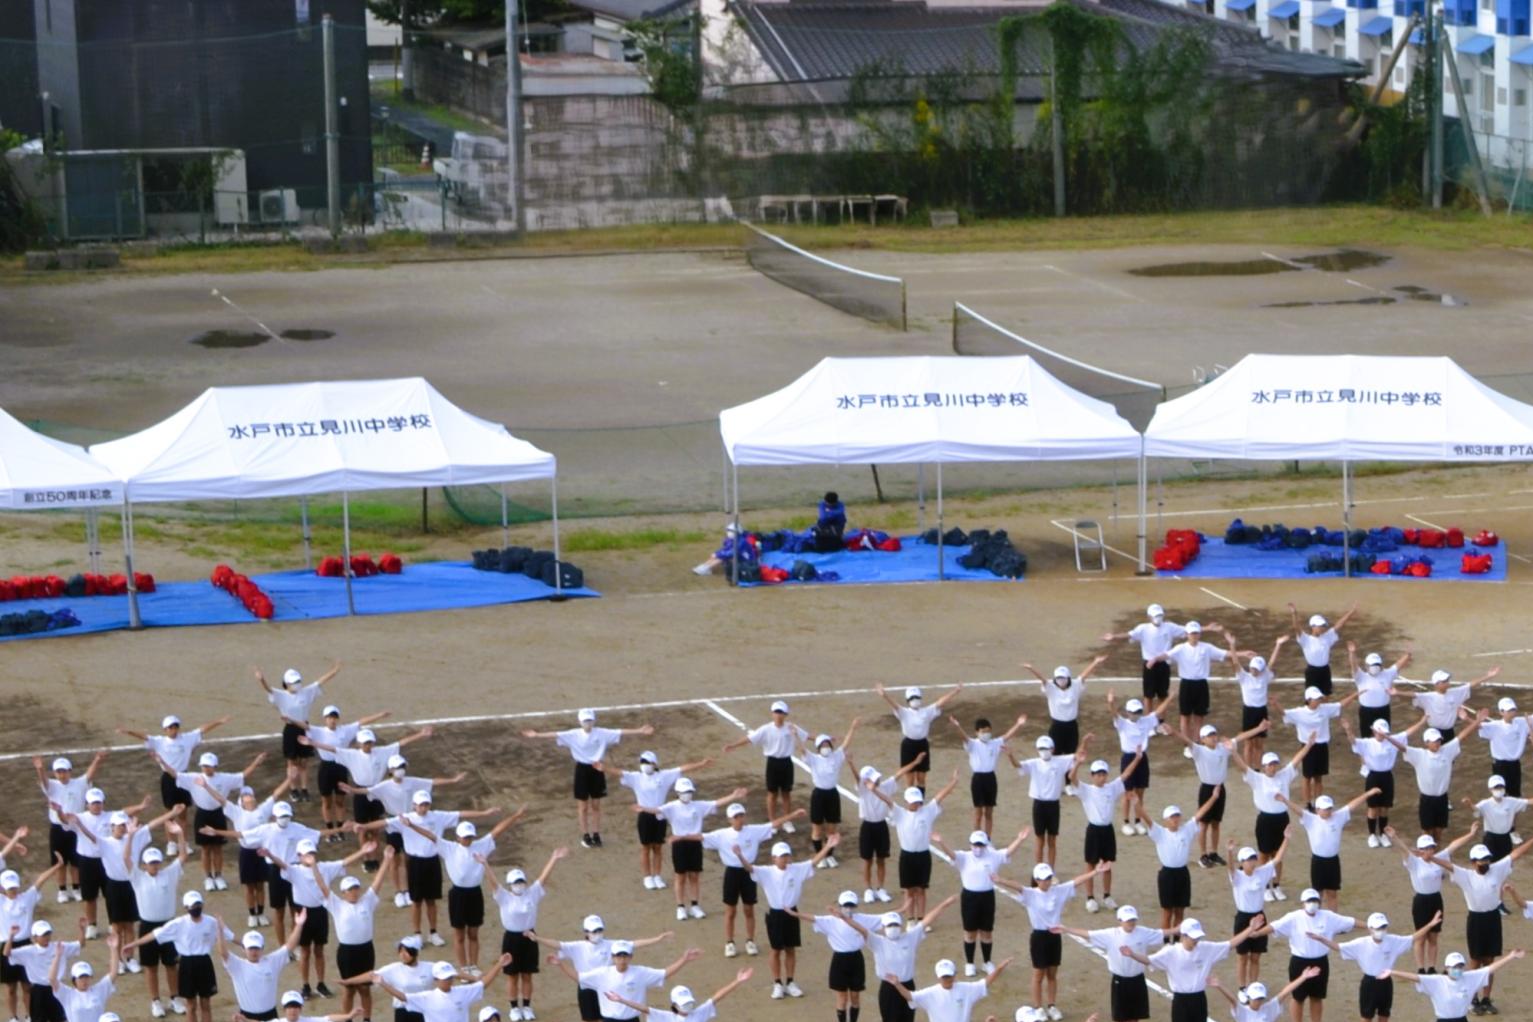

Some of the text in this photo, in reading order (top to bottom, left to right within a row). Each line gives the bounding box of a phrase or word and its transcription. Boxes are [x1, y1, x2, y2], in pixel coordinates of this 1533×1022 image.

[837, 392, 1029, 410] 水戸市立見川中学校
[1250, 388, 1443, 406] 水戸市立見川中学校
[228, 413, 433, 440] 水戸市立見川中学校
[1453, 444, 1504, 456] 令和3年度
